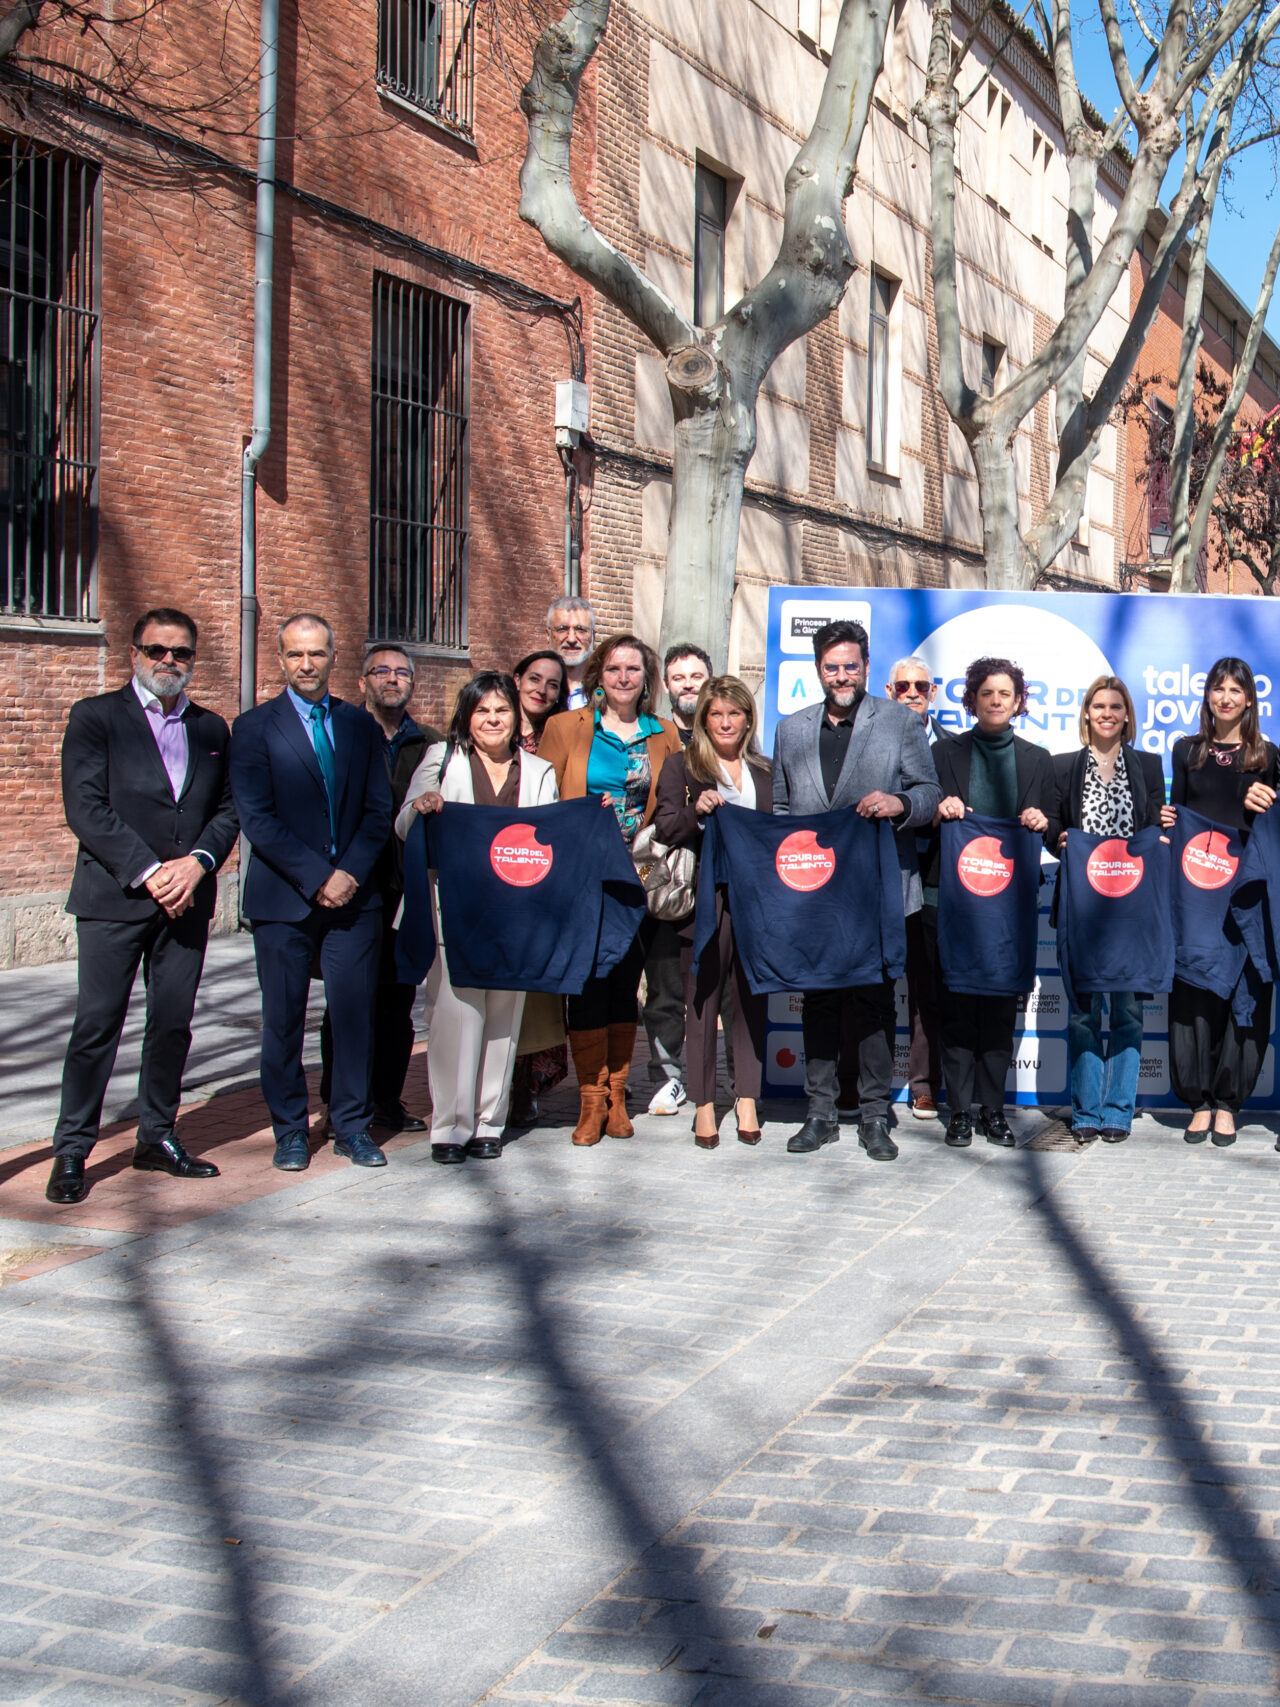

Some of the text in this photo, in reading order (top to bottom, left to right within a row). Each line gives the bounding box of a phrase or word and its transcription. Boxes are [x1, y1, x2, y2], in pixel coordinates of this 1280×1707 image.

[794, 618, 827, 627] Princesa
[1142, 663, 1273, 699] taleo
[494, 846, 529, 856] TOUR
[1188, 846, 1218, 862] TOUR
[494, 856, 550, 865] TALENTO
[779, 853, 812, 862] TOUR
[779, 861, 833, 870] TALENTO
[962, 857, 1007, 870] TOUR DEL
[1090, 861, 1122, 869] TOUR
[1186, 854, 1233, 875] TALENTO
[961, 865, 1011, 878] TALENTO
